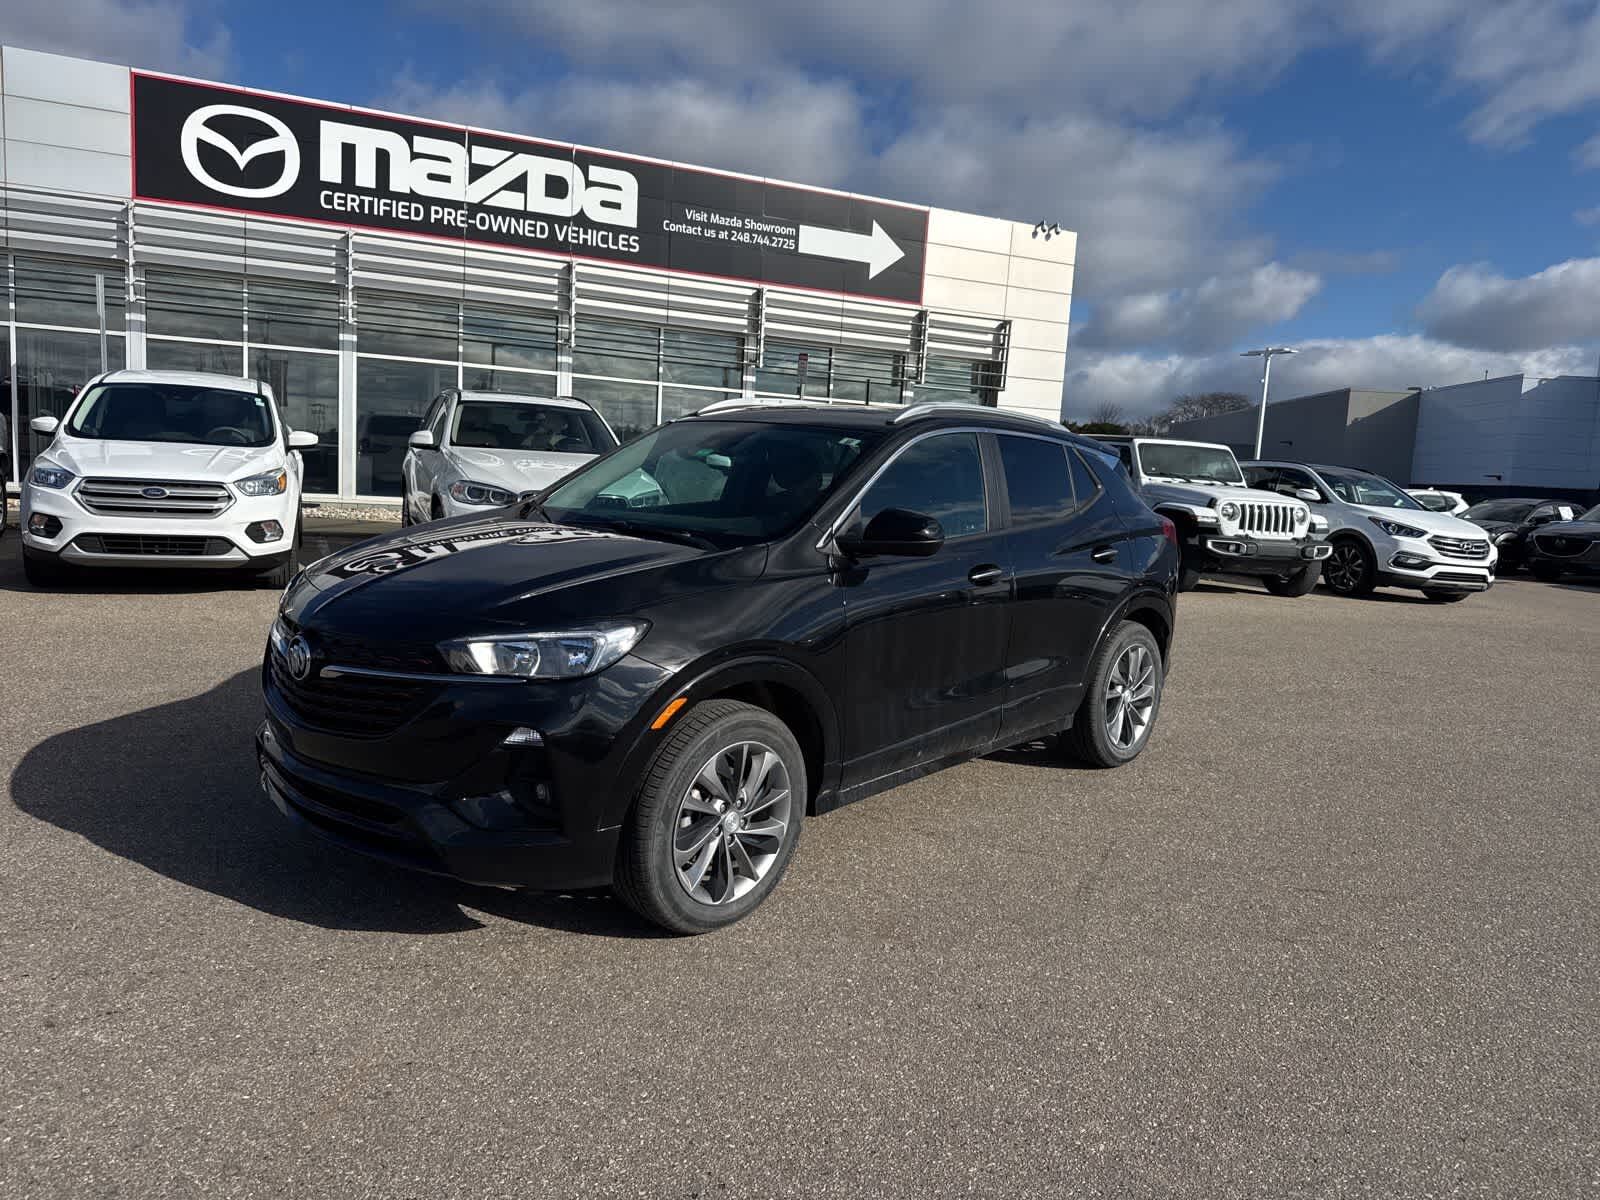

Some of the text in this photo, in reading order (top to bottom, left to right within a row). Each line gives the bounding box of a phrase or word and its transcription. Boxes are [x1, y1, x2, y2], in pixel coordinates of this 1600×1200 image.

[320, 190, 640, 253] CERTIFIED PRE-OWNED VEHICLES
[663, 220, 796, 250] Contact us at 248.744.2725
[685, 208, 796, 236] Visit Mazda Showroom
